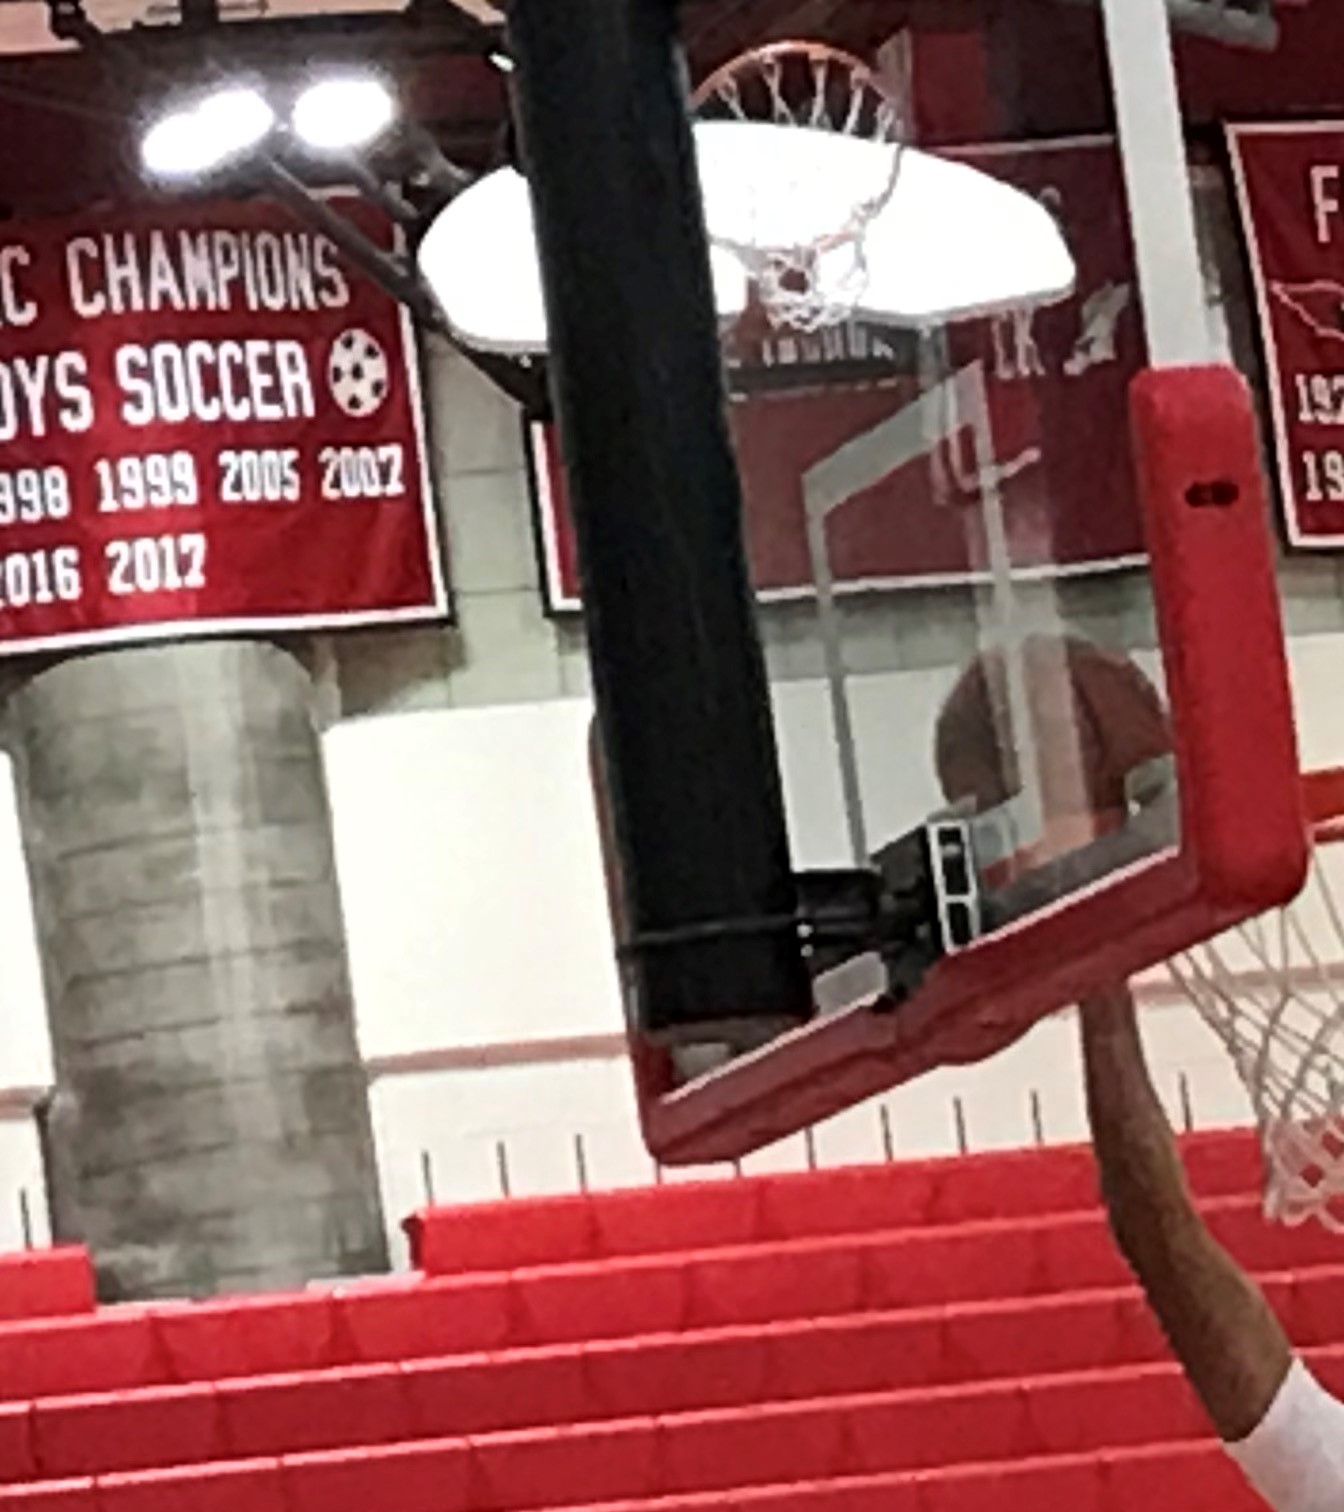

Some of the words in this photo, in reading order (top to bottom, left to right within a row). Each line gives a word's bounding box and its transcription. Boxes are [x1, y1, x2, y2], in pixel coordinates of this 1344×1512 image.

[66, 230, 349, 319] CHAMPIONS
[115, 340, 315, 425] SOCCER
[94, 451, 198, 512] 1999
[218, 449, 300, 502] 2005
[318, 443, 405, 499] 2007
[0, 546, 81, 608] 016
[105, 532, 206, 596] 2017
